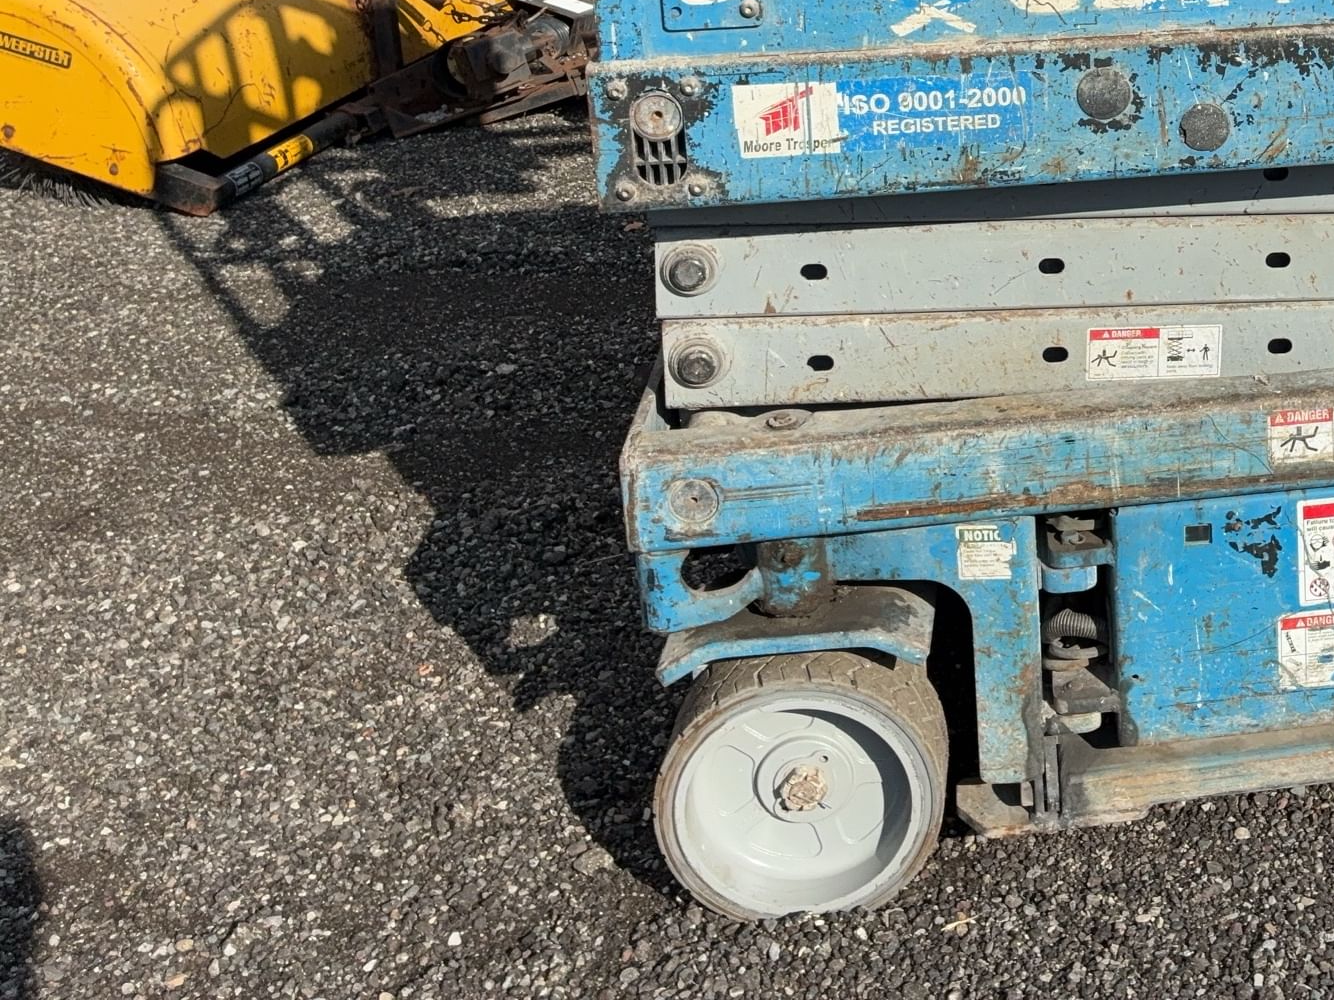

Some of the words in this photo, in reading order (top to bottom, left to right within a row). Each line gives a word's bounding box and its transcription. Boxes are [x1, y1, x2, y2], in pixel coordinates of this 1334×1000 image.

[0, 33, 70, 67] WEEPSTER
[843, 93, 890, 115] ISO
[898, 86, 1027, 112] 9001-2000
[872, 113, 1001, 136] REGISTERED
[743, 140, 782, 153] Moore
[1111, 329, 1142, 338] DANGER
[1286, 409, 1330, 422] DANGER
[964, 530, 1001, 541] NOTIC
